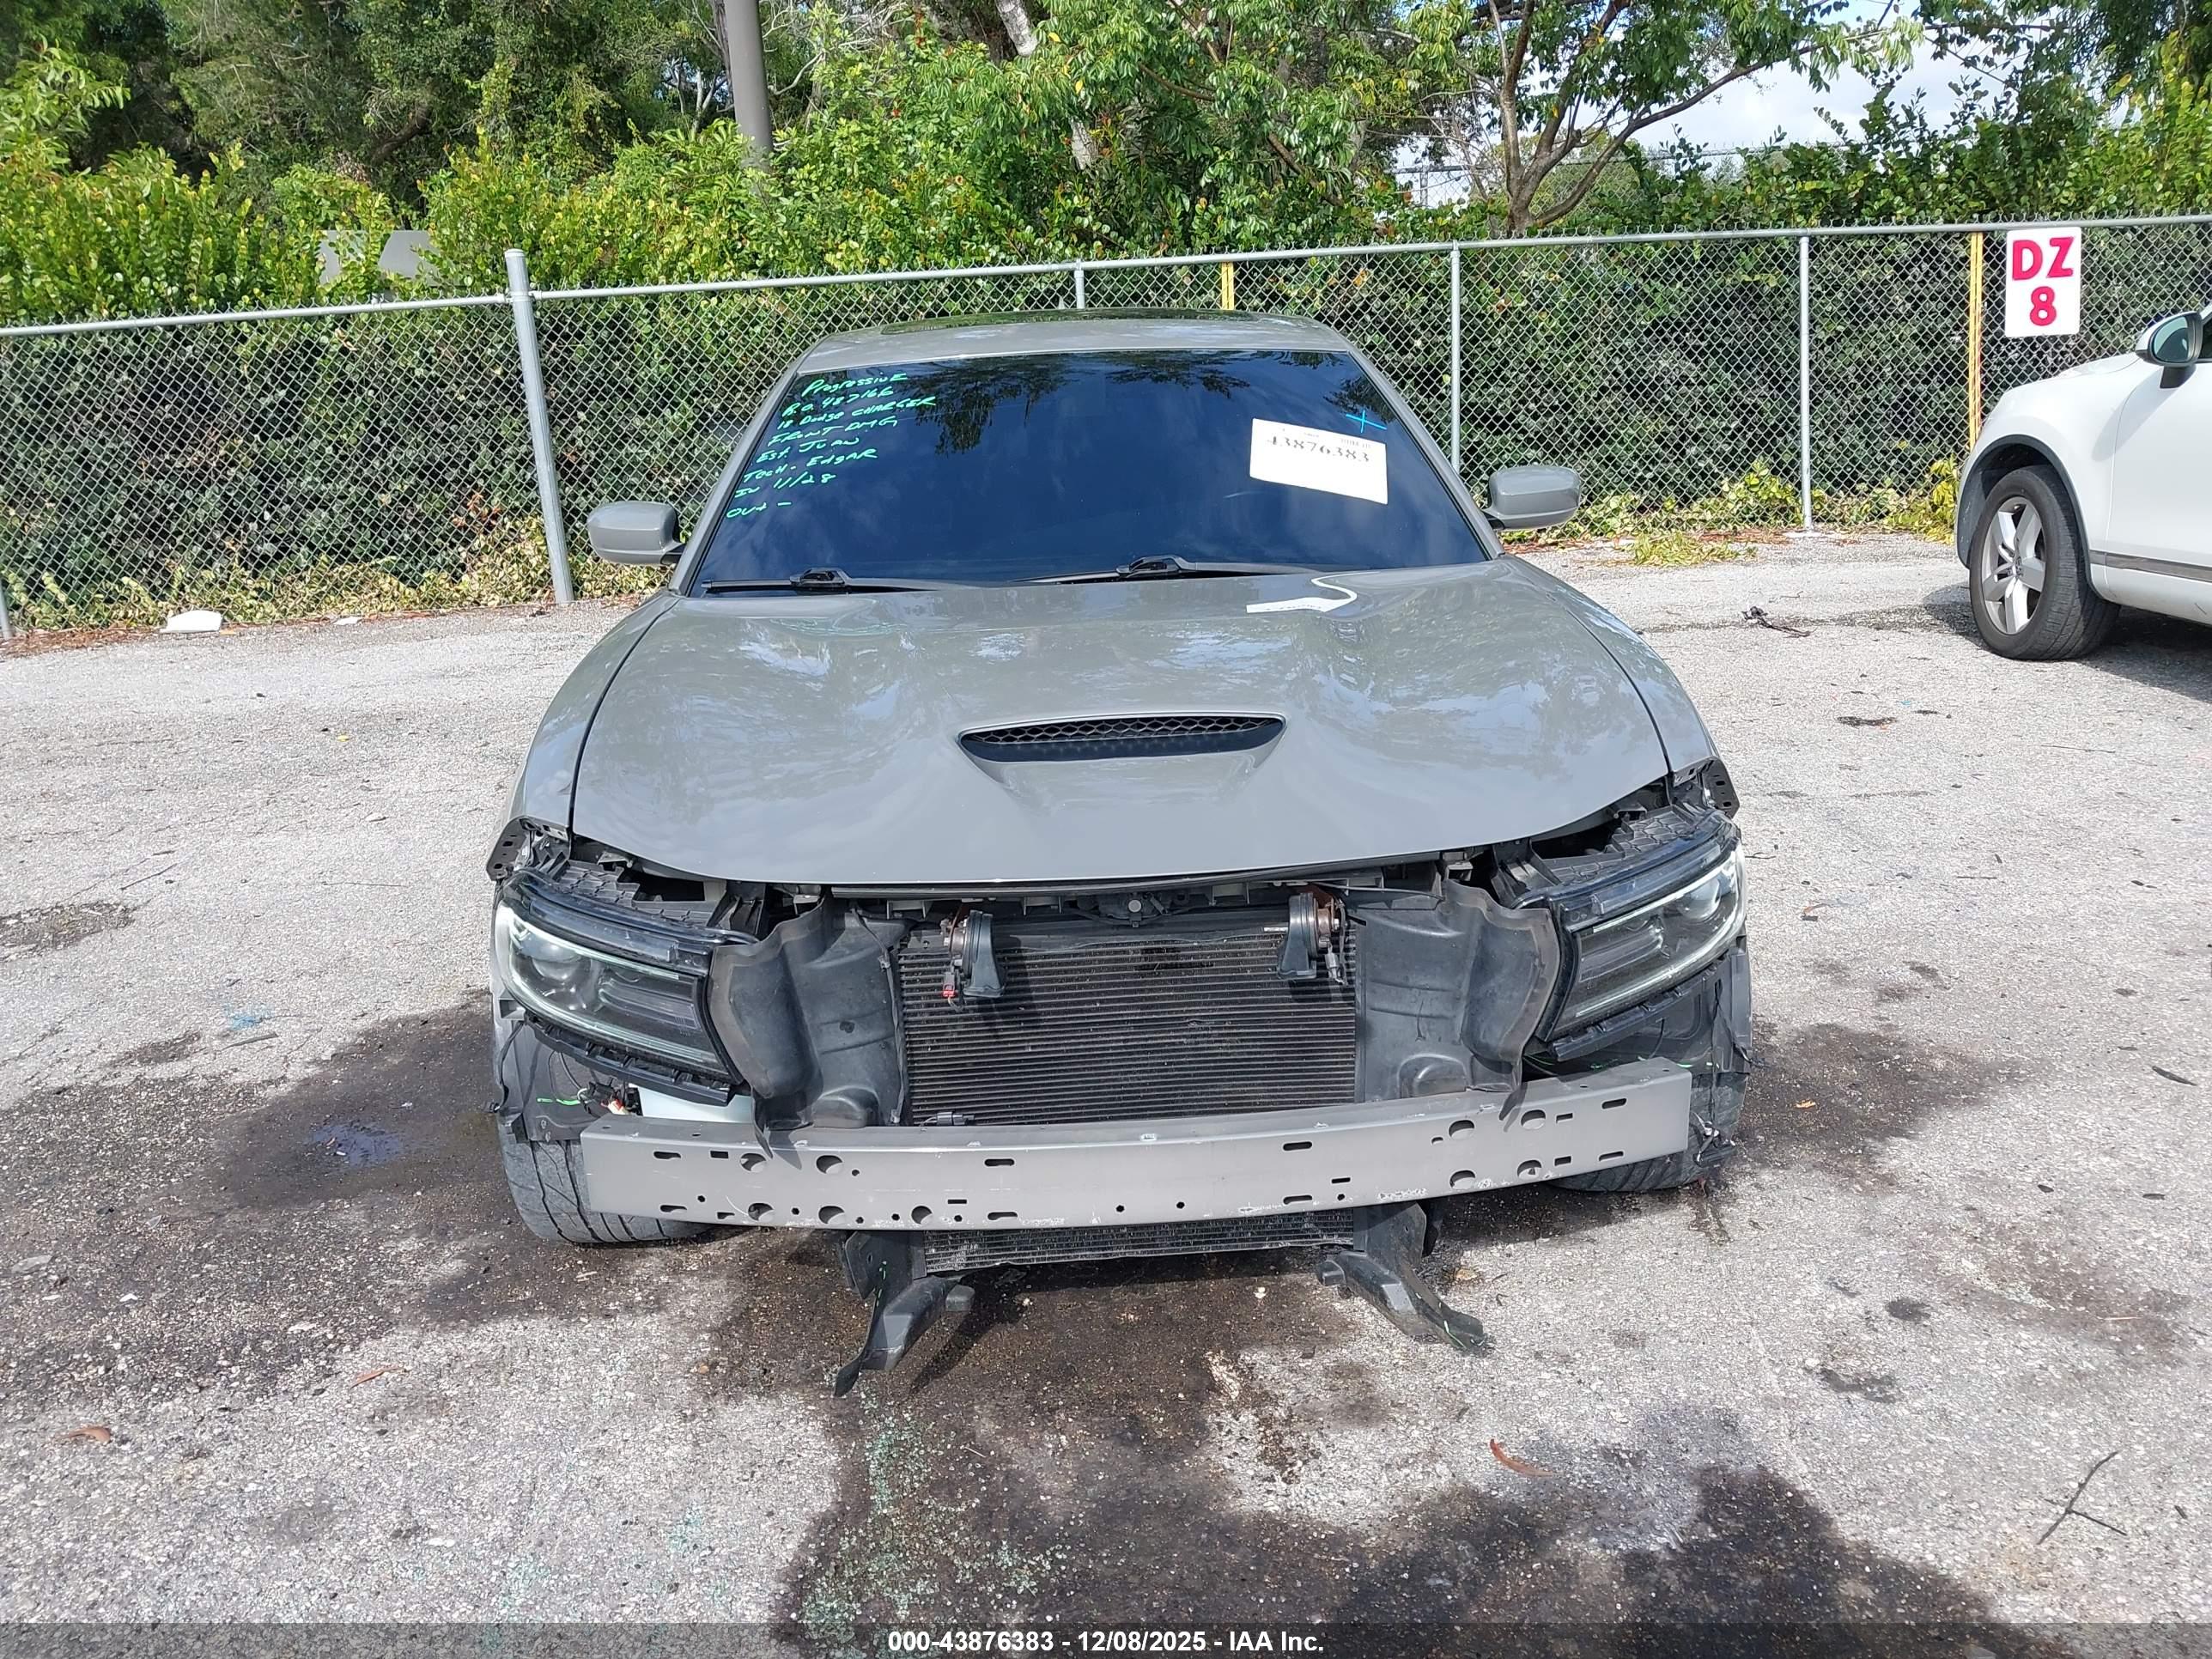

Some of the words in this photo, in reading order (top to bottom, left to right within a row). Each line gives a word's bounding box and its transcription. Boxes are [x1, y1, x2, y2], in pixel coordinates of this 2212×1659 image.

[2013, 237, 2074, 281] DZ
[2030, 286, 2057, 326] 8
[776, 419, 793, 430] 18
[845, 416, 897, 431] DMG
[1267, 434, 1370, 463] 43876383
